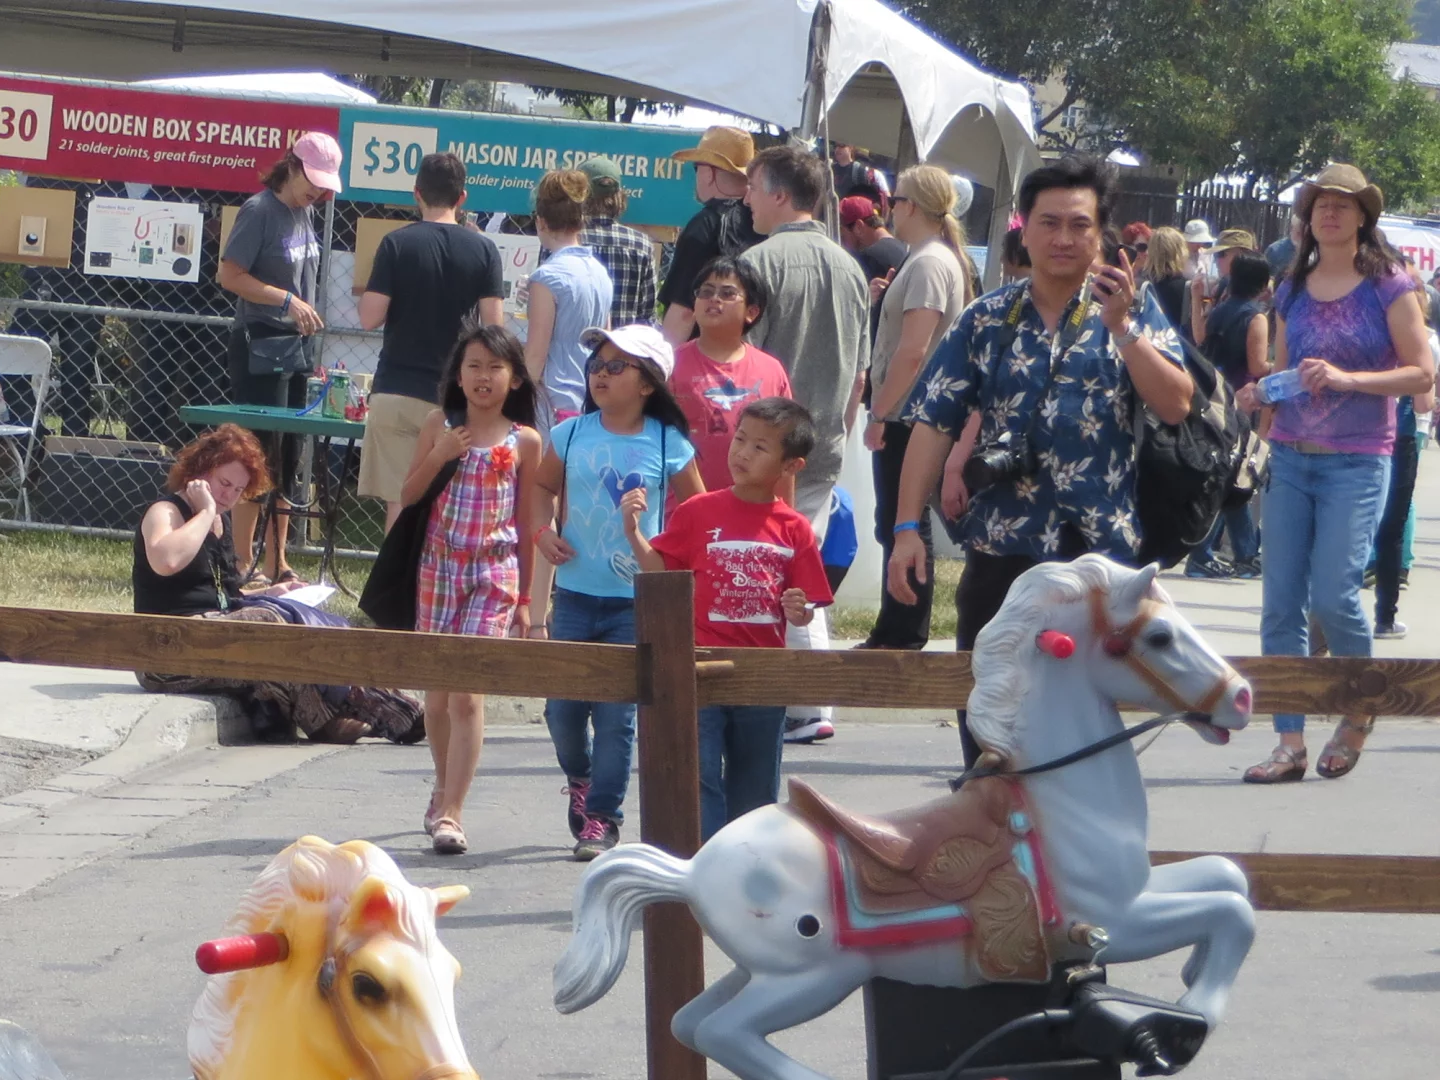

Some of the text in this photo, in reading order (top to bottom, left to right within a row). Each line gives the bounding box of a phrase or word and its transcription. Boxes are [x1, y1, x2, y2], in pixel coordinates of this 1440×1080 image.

[62, 108, 148, 138] WOODEN
[152, 117, 192, 142] BOX
[195, 121, 281, 149] SPEAKER
[59, 139, 256, 170] 21 solder joints, great first project
[363, 136, 423, 176] $30
[448, 141, 685, 181] MASON JAR SPKER KIT
